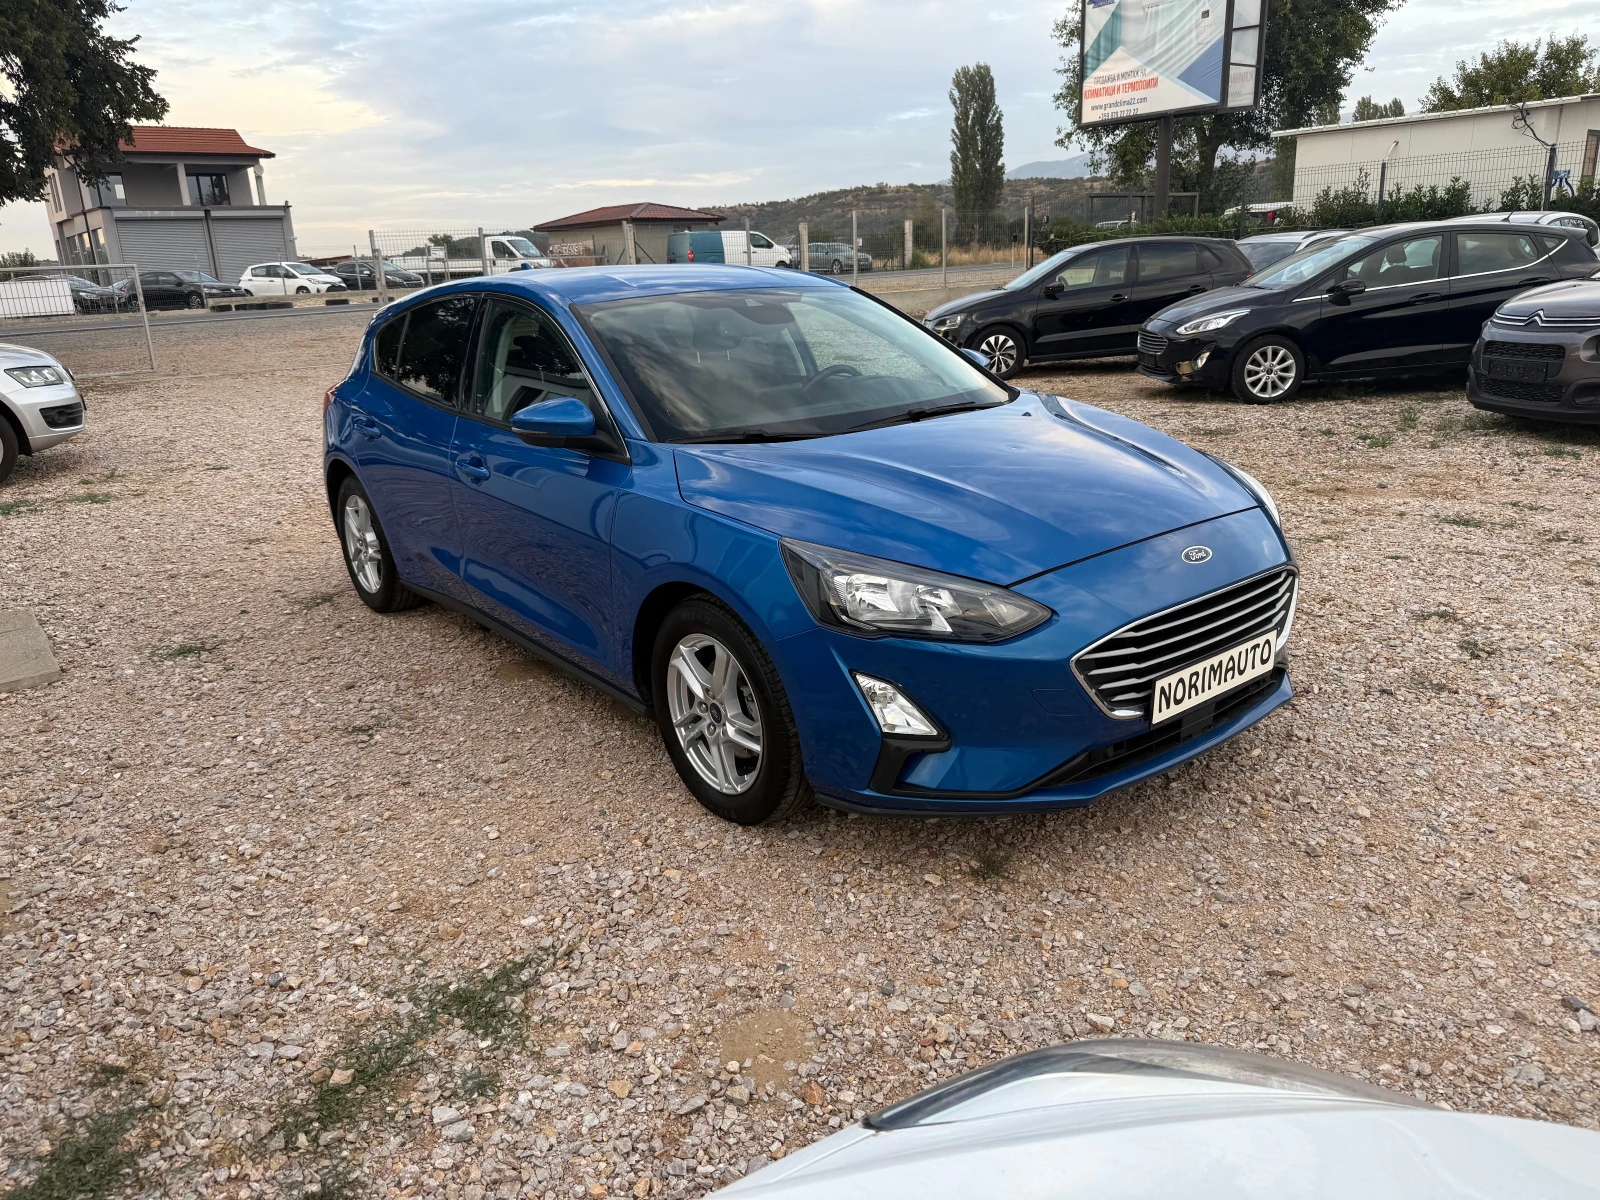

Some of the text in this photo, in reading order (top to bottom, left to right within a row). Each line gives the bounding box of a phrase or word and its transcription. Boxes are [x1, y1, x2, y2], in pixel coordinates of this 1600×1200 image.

[1084, 77, 1159, 100] КЛИМАТИЦИ И ТЕРМОПОМПИ
[1091, 97, 1148, 113] www.grandclima22.com
[1158, 638, 1272, 714] NORIMAUTO
